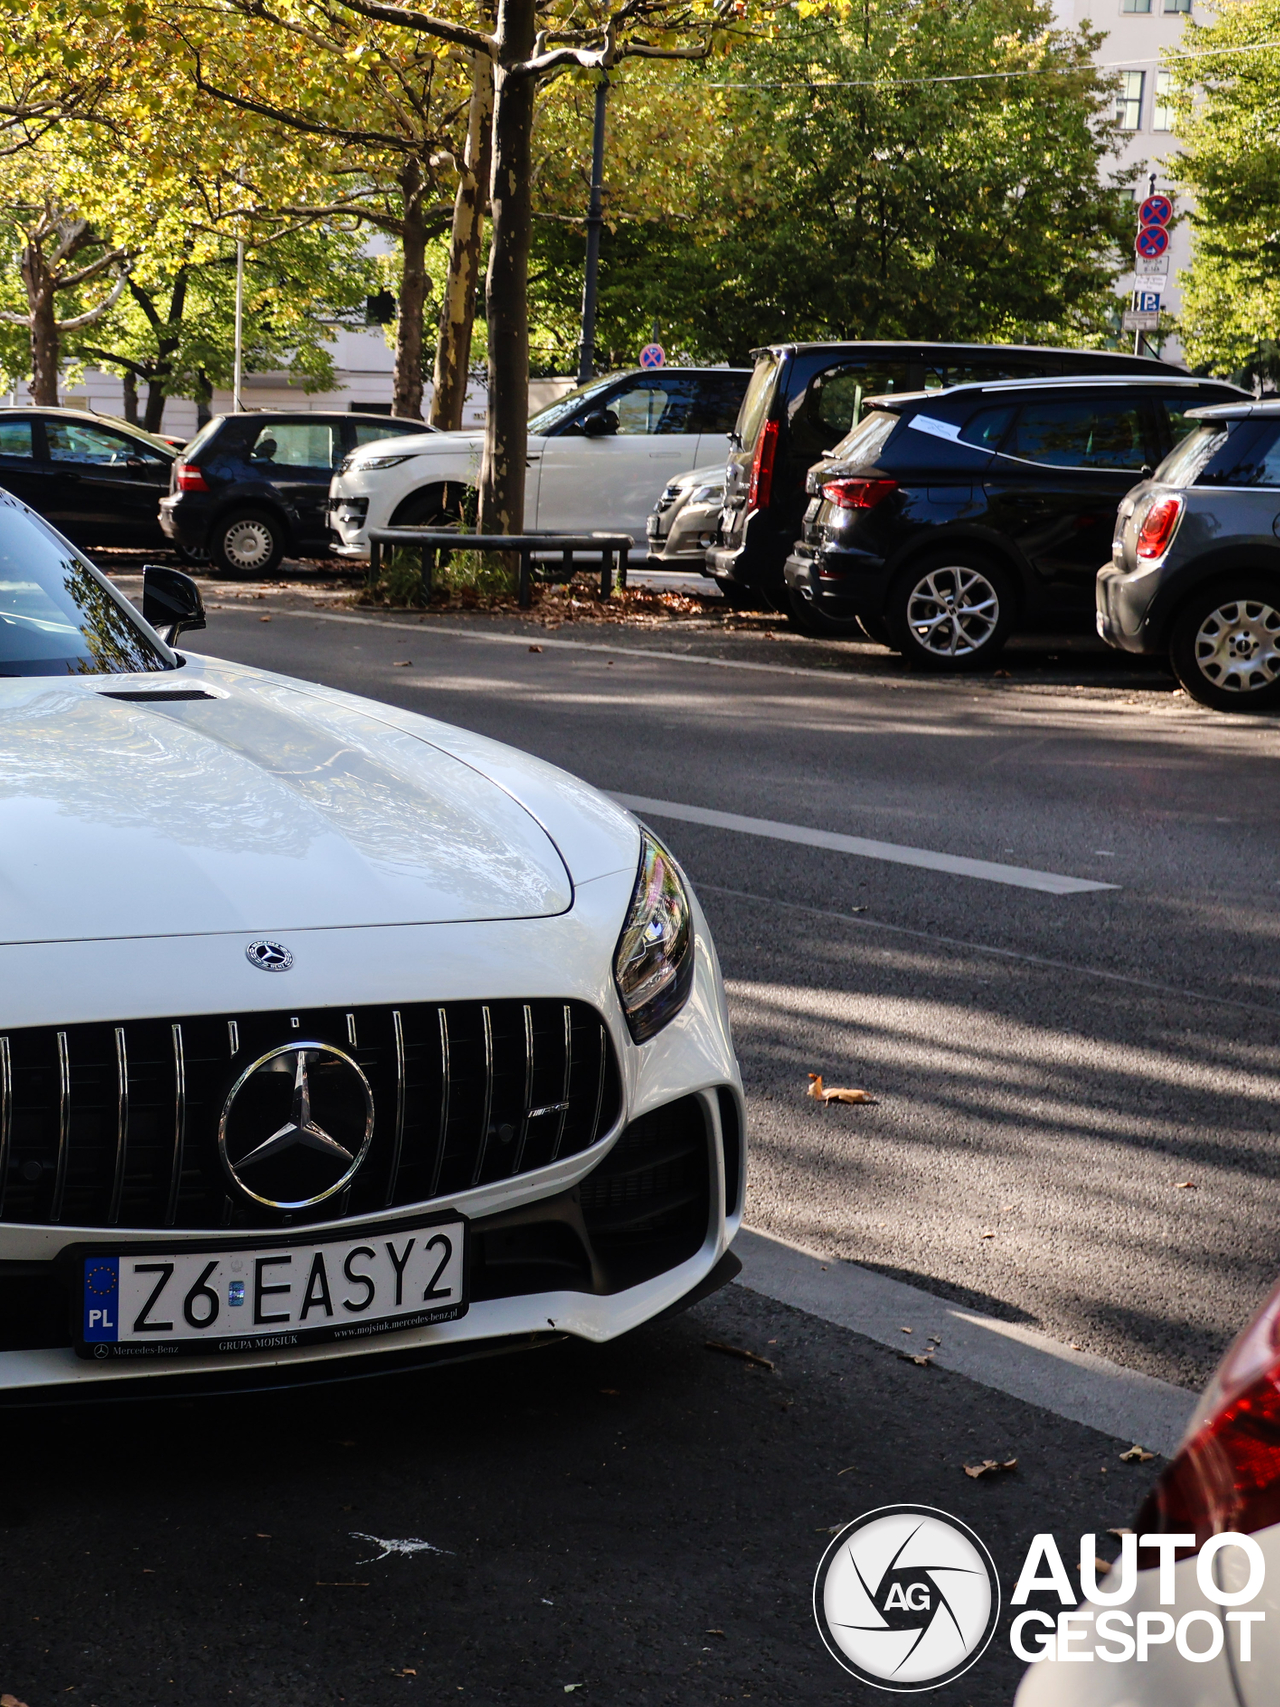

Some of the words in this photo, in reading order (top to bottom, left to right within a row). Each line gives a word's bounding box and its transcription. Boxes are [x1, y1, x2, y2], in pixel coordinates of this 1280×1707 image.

[133, 1260, 220, 1333] Z6
[253, 1233, 453, 1326] EASY2
[89, 1309, 113, 1328] PL
[333, 1308, 458, 1338] www.mojsiuk.mercedes-benz.pl
[113, 1345, 179, 1355] Mercedes-Benz
[218, 1338, 253, 1351] GRUPA
[254, 1335, 298, 1349] MOJSIUK
